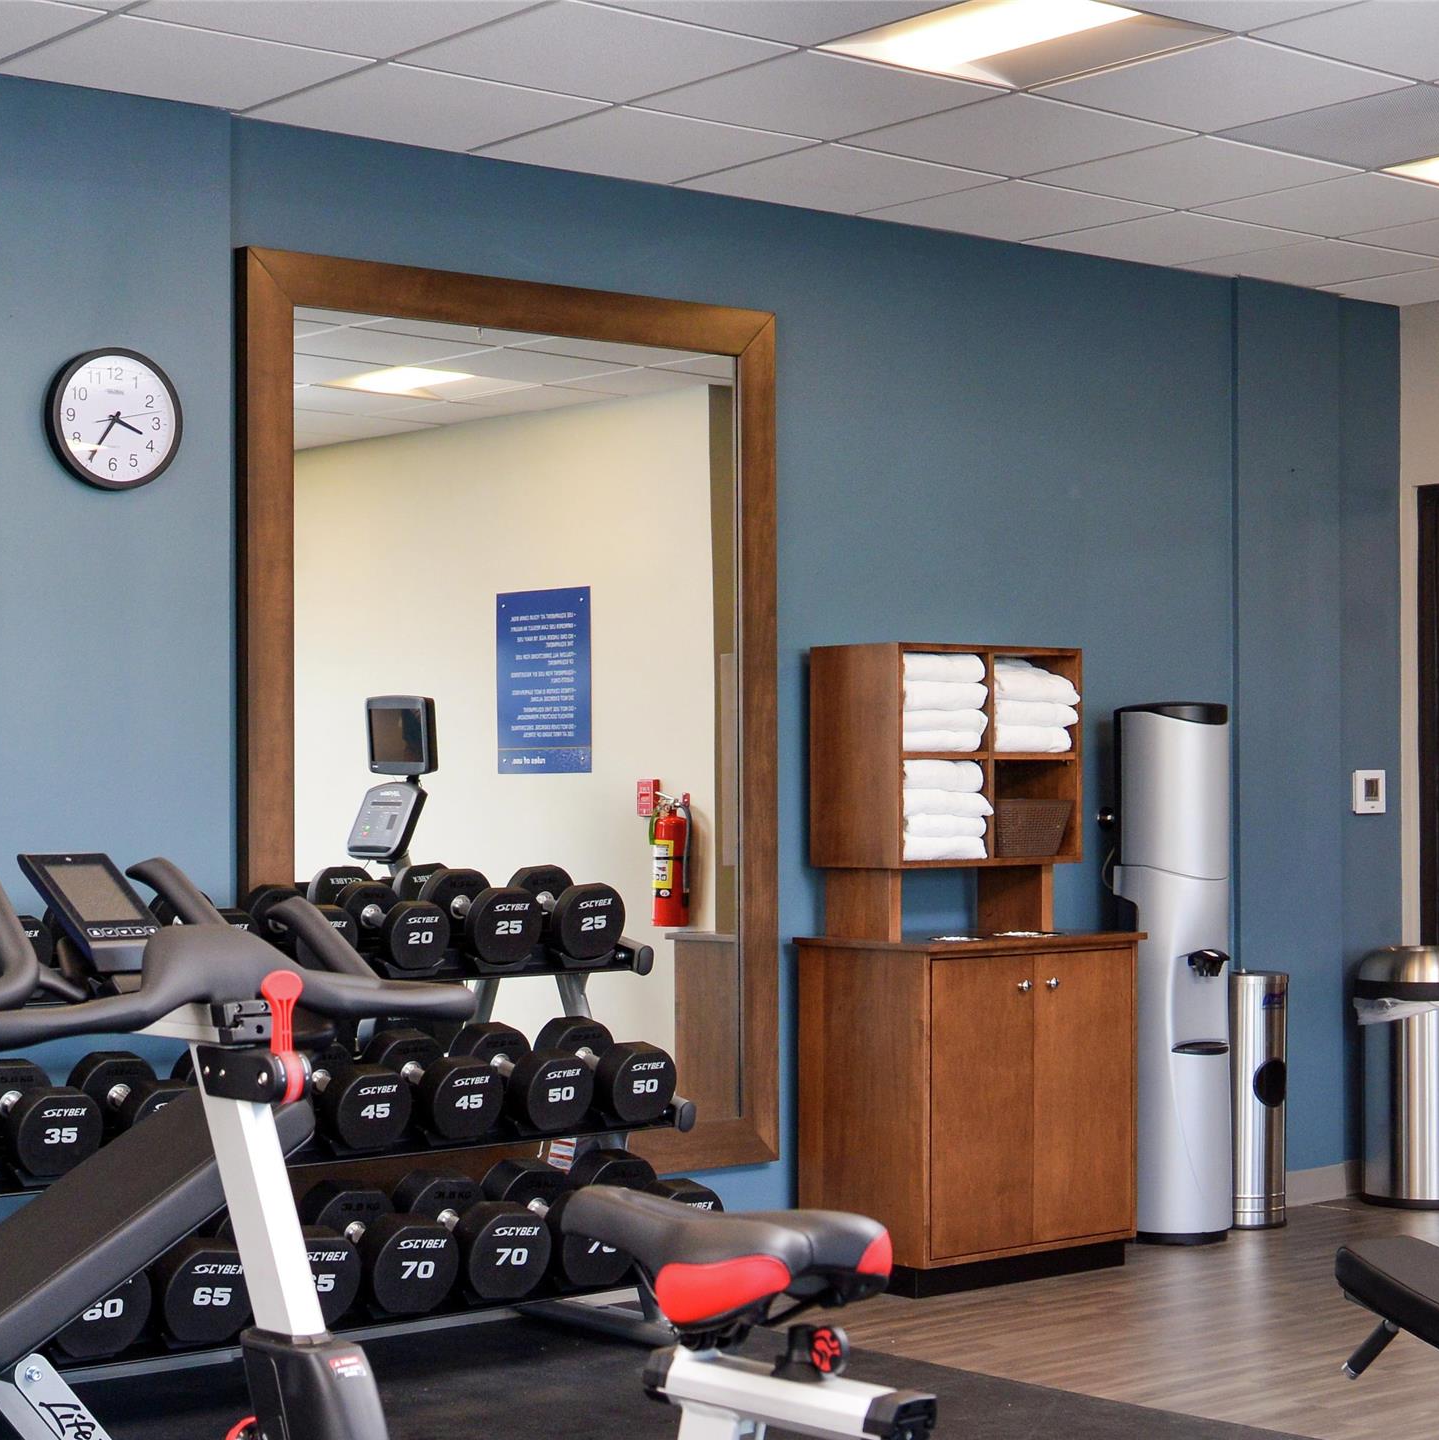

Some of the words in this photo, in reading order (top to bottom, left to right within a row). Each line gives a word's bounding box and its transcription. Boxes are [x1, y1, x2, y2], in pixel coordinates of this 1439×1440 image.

[89, 371, 101, 385] 11
[107, 367, 124, 381] 12
[132, 376, 138, 389] 1
[72, 387, 88, 401] 10
[145, 395, 154, 408] 2
[66, 408, 76, 421] 9
[151, 417, 161, 431] 3
[146, 440, 155, 453] 4
[108, 457, 118, 471] 6
[129, 454, 138, 467] 5
[505, 903, 530, 912] CYBEX
[588, 898, 613, 908] CYBEX
[495, 920, 523, 935] 25
[580, 915, 607, 932] 25
[407, 931, 434, 945] 20
[641, 1061, 666, 1071] CYBEX
[463, 1075, 490, 1086] CYBEX
[556, 1068, 582, 1079] CYBEX
[370, 1084, 398, 1095] CYBEX
[632, 1078, 659, 1094] 50
[455, 1093, 484, 1110] 45
[548, 1086, 575, 1103] 50
[55, 1107, 88, 1118] CYBEX
[360, 1103, 391, 1120] 45
[43, 1127, 79, 1145] 35
[506, 1226, 541, 1237] CYBEX
[412, 1238, 447, 1249] CYBEX
[312, 1251, 348, 1261] CYBEX
[495, 1248, 529, 1266] 70
[206, 1264, 245, 1275] CYBEX
[400, 1260, 435, 1280] 70
[312, 1274, 336, 1292] 5
[192, 1287, 233, 1306] 65
[39, 1402, 96, 1440] Life
